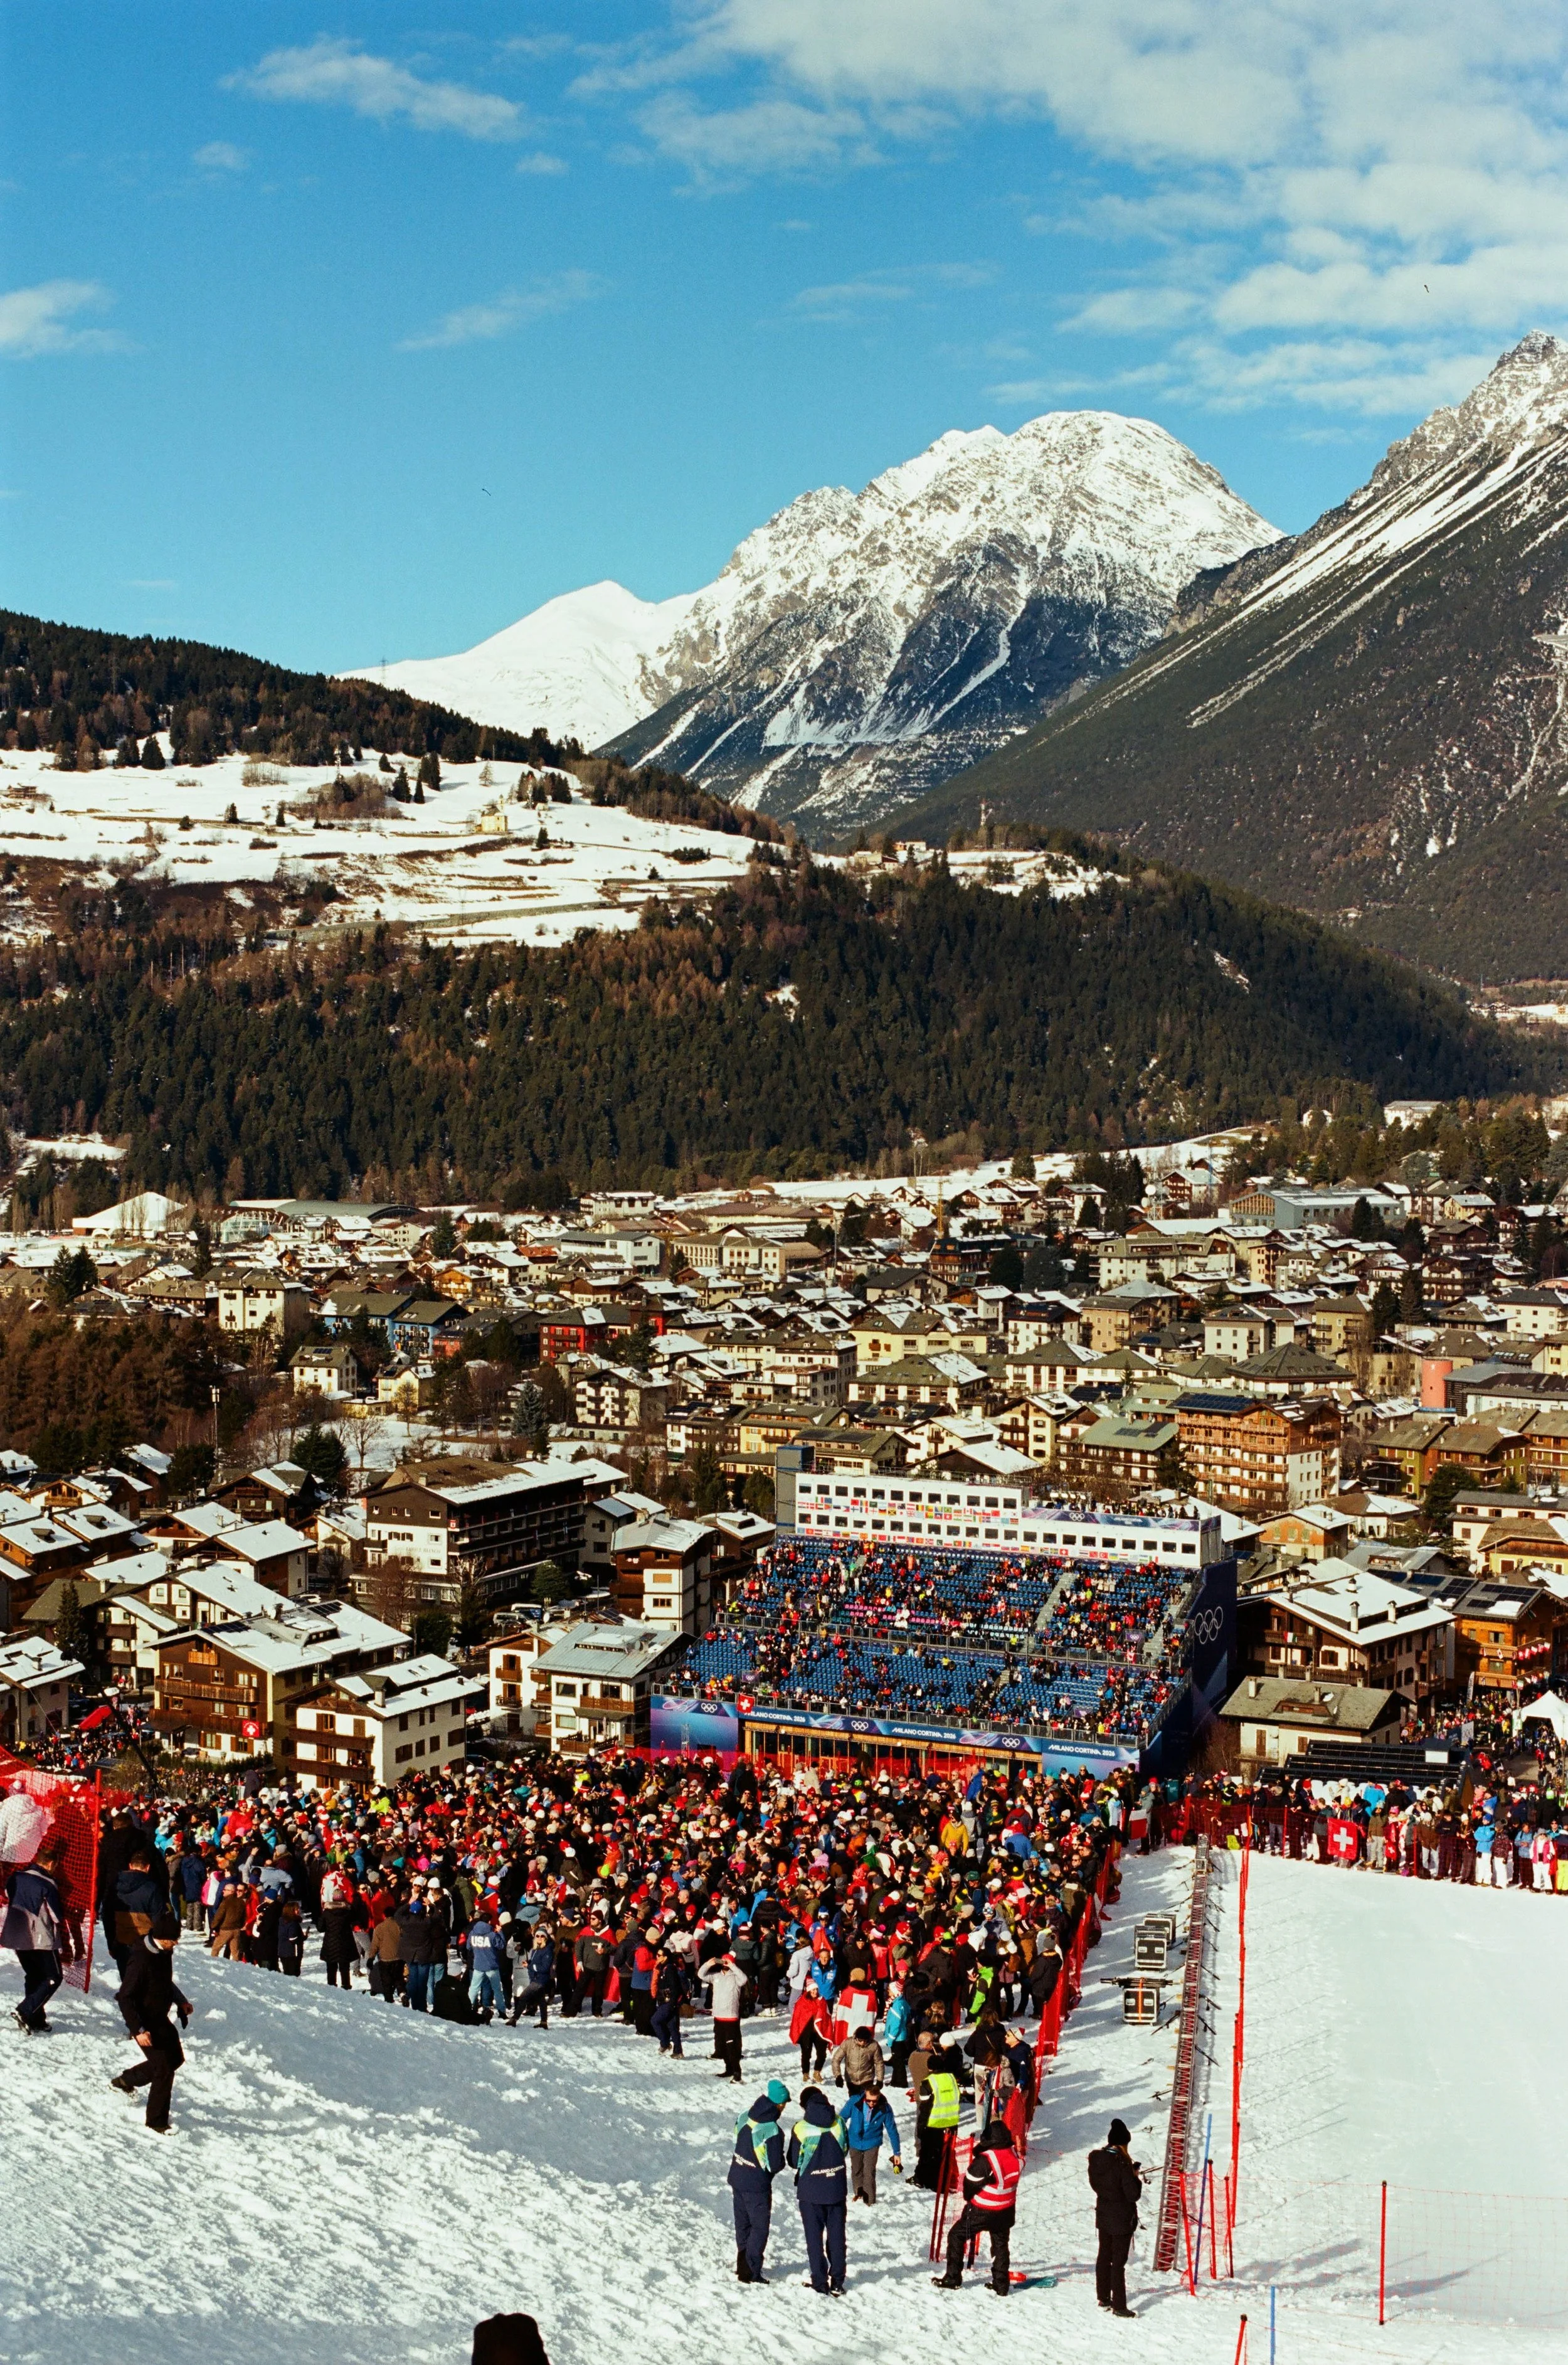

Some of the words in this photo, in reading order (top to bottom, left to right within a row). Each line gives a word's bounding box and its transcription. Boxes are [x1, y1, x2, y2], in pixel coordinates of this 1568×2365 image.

[768, 1713, 793, 1721] CORTINA
[891, 1727, 916, 1735] MILANO
[917, 1730, 943, 1738] CORTINA
[1048, 1744, 1074, 1752] MILANO
[1074, 1746, 1101, 1755] CORTINA
[471, 1935, 491, 1948] USA
